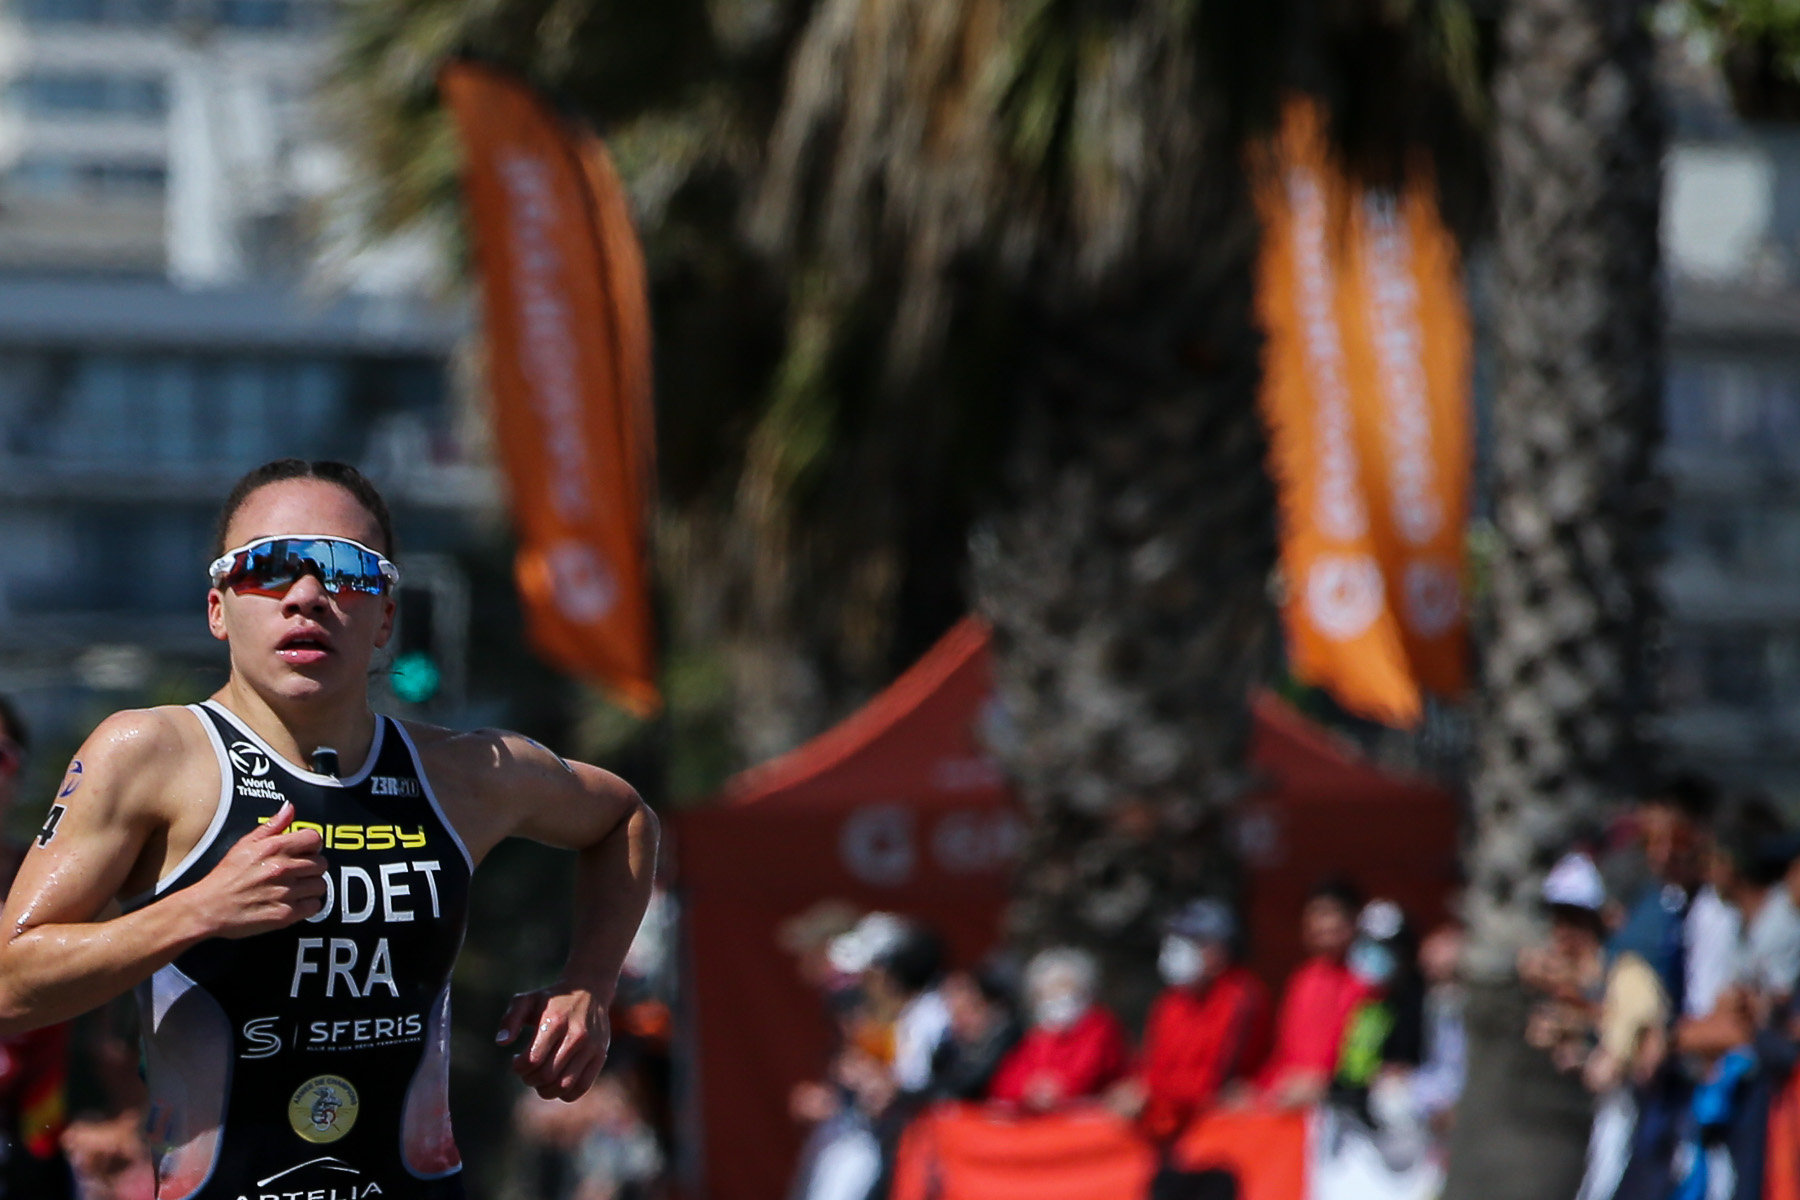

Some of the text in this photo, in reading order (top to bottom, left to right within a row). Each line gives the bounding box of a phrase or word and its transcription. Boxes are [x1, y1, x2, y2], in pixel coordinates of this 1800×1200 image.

[241, 777, 276, 791] World
[236, 785, 286, 802] Triathlon
[290, 937, 400, 998] FRA
